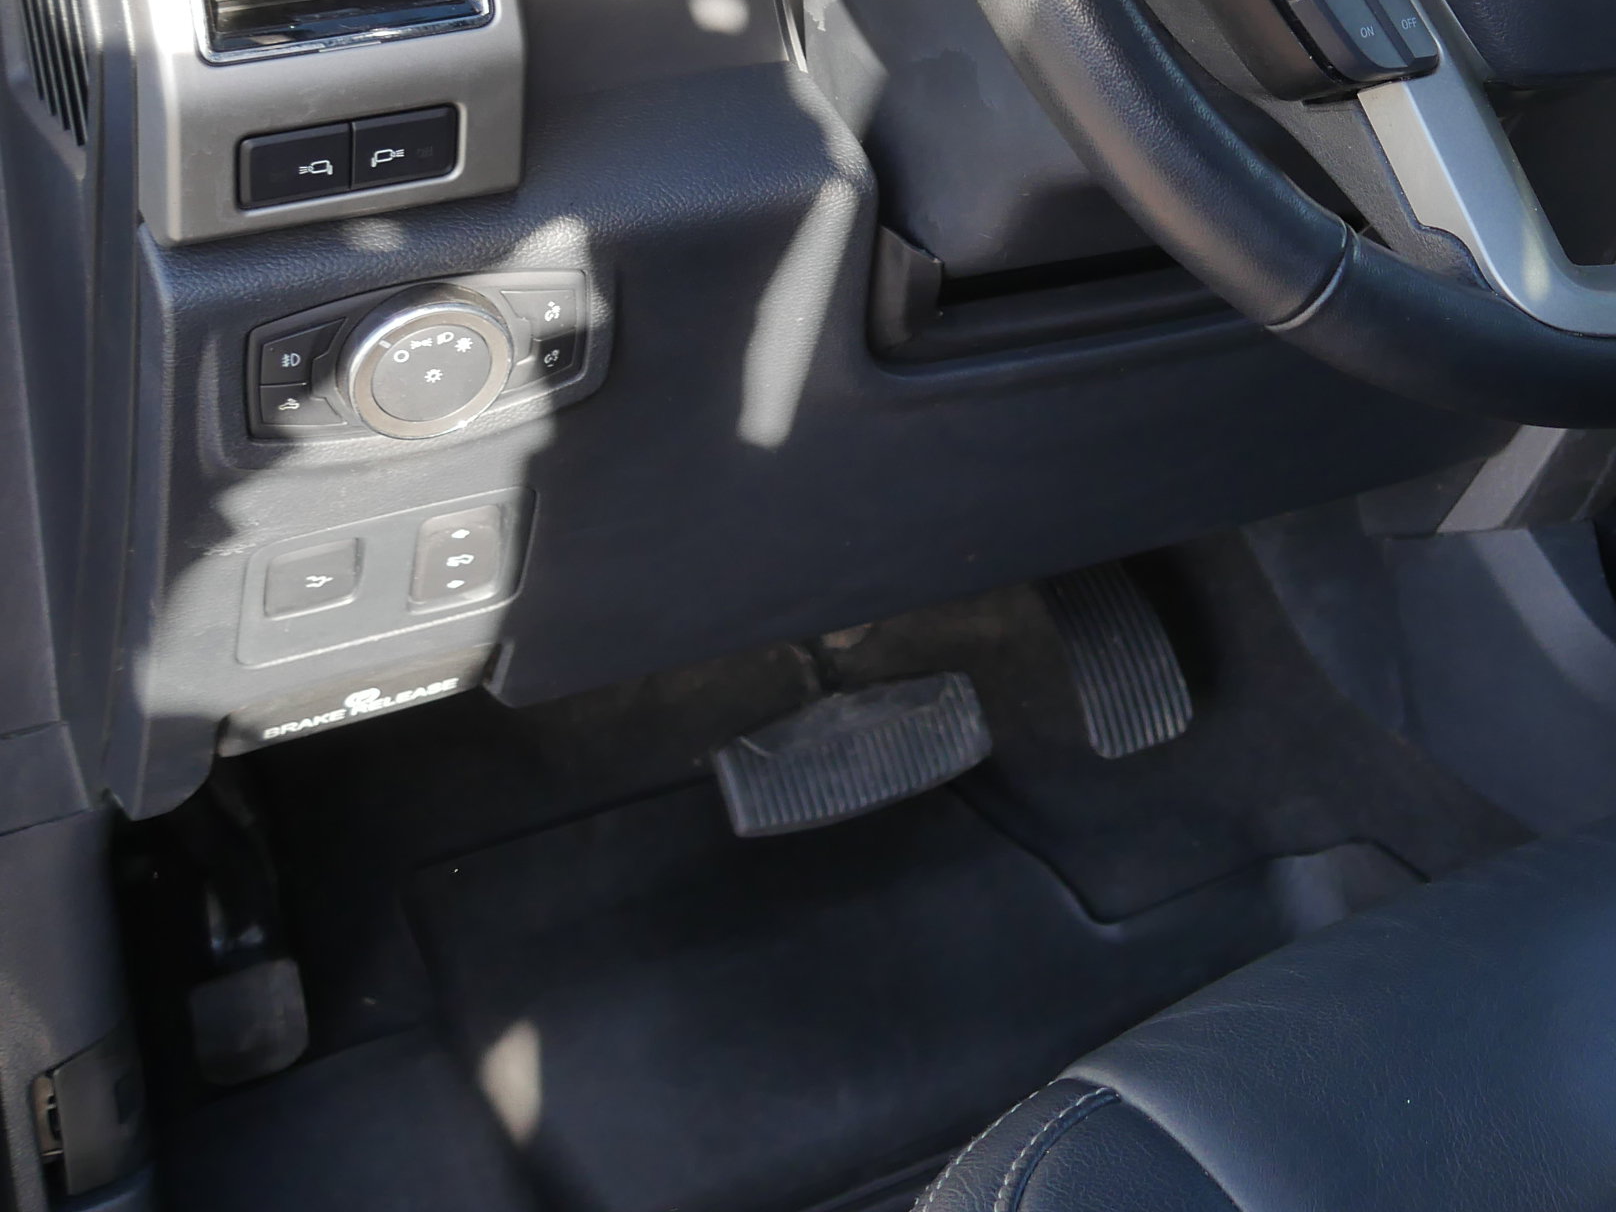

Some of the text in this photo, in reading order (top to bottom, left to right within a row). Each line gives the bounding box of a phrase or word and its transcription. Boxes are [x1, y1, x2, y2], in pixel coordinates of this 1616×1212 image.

[1401, 17, 1418, 30] OFF
[1360, 26, 1375, 38] ON
[264, 678, 459, 739] BRAKE RELEASE
